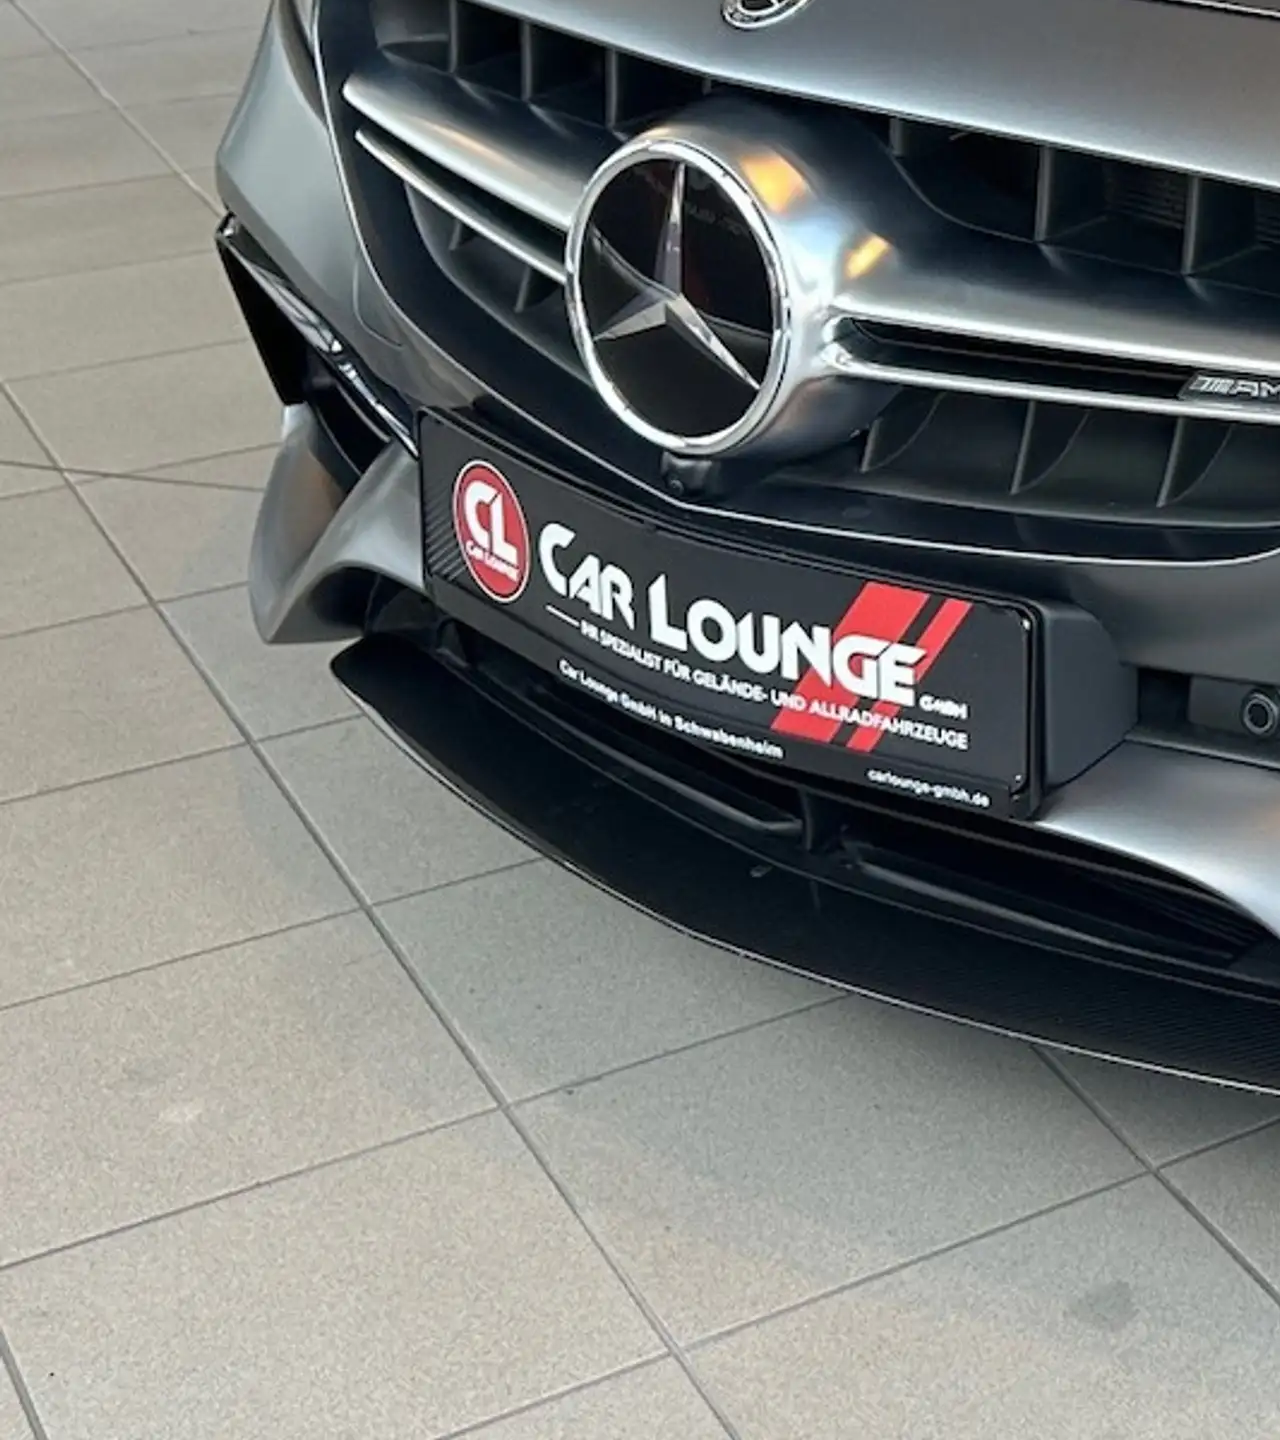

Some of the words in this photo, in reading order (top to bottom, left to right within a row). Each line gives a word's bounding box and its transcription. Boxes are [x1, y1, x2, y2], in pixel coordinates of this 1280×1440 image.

[465, 479, 518, 569] CL
[538, 522, 635, 631] CAR
[648, 573, 928, 706] LOUNGE
[558, 659, 579, 681] Car
[657, 709, 673, 727] in
[581, 619, 600, 643] IHR
[599, 628, 663, 672] SPEZIALIST
[663, 656, 692, 682] FÜR
[770, 689, 807, 712] UND
[808, 700, 968, 751] ALLRADFAHRZEUGE
[866, 768, 990, 808] carlounge-gmbh.de
